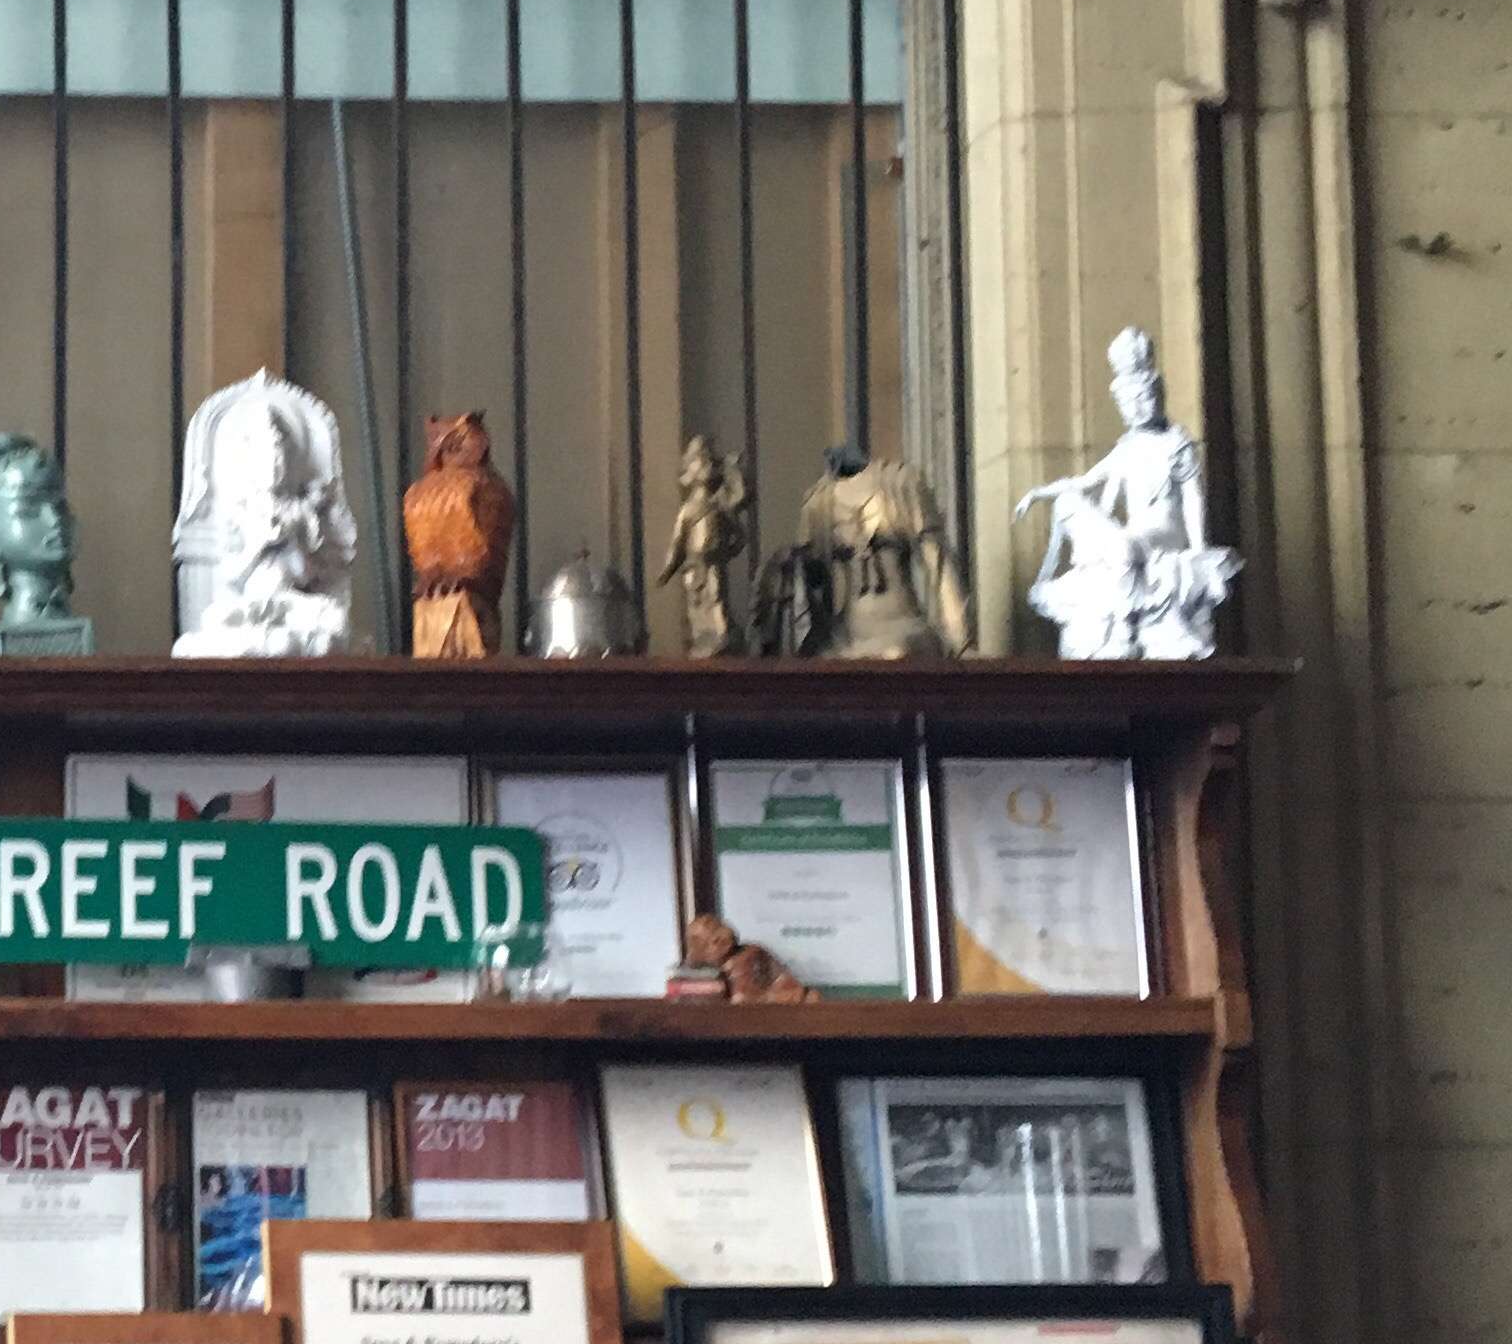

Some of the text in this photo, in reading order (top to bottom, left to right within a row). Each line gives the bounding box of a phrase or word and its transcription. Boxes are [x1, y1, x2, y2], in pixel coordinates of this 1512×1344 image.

[285, 842, 524, 943] ROAD
[414, 1093, 526, 1122] ZAGAT
[354, 1276, 529, 1312] New Times
